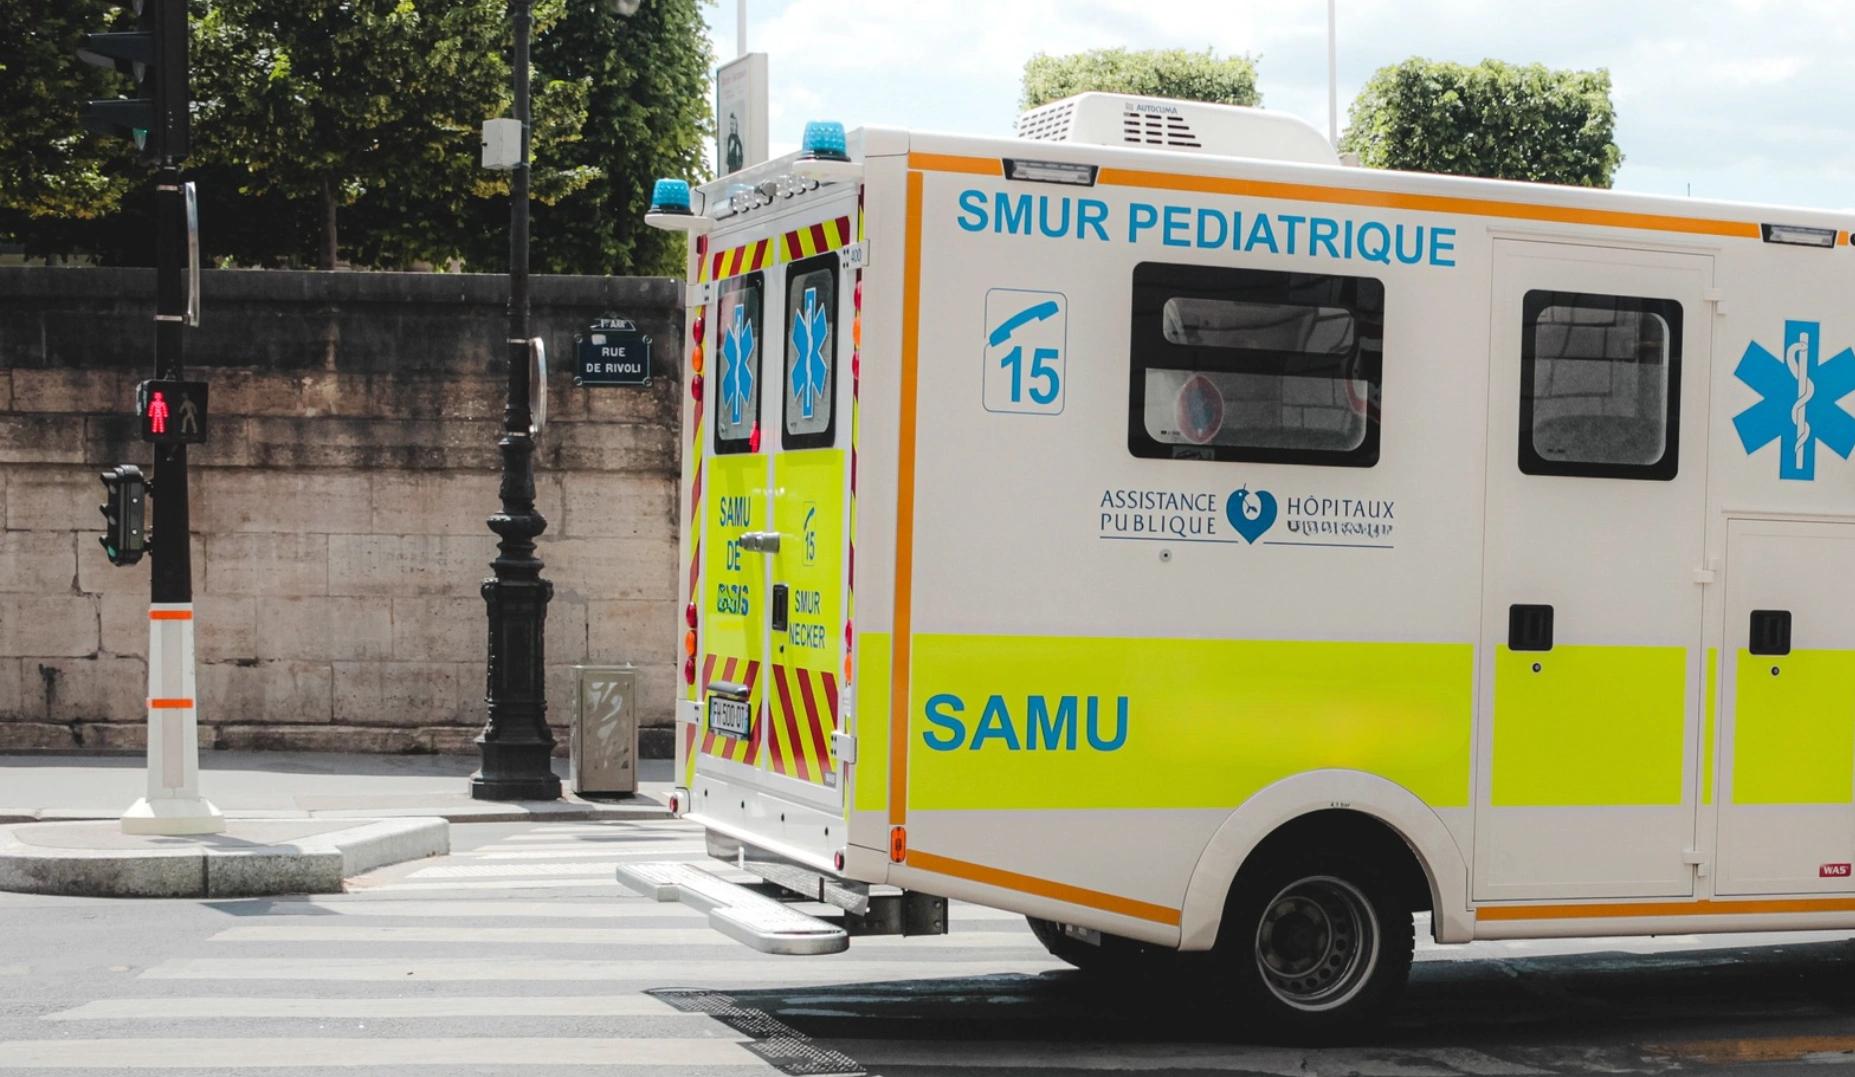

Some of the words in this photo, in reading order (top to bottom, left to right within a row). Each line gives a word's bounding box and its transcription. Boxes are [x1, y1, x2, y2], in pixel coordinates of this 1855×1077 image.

[957, 189, 1110, 241] SMUR
[1128, 203, 1456, 267] PEDIATRIQUE
[601, 346, 626, 357] RUE
[586, 363, 601, 373] DE
[605, 363, 641, 373] RIVOLI
[1001, 345, 1060, 405] 15
[720, 496, 750, 527] SAMU
[1100, 489, 1216, 512] ASSISTANCE
[1287, 495, 1394, 519] HÔPITAUX
[1101, 513, 1216, 538] PUBLIQUE
[727, 540, 741, 571] DE
[805, 531, 815, 560] 15
[794, 590, 820, 615] SMUR
[789, 622, 825, 648] NECKER
[922, 693, 1129, 752] SAMU
[1823, 866, 1847, 875] WAS
